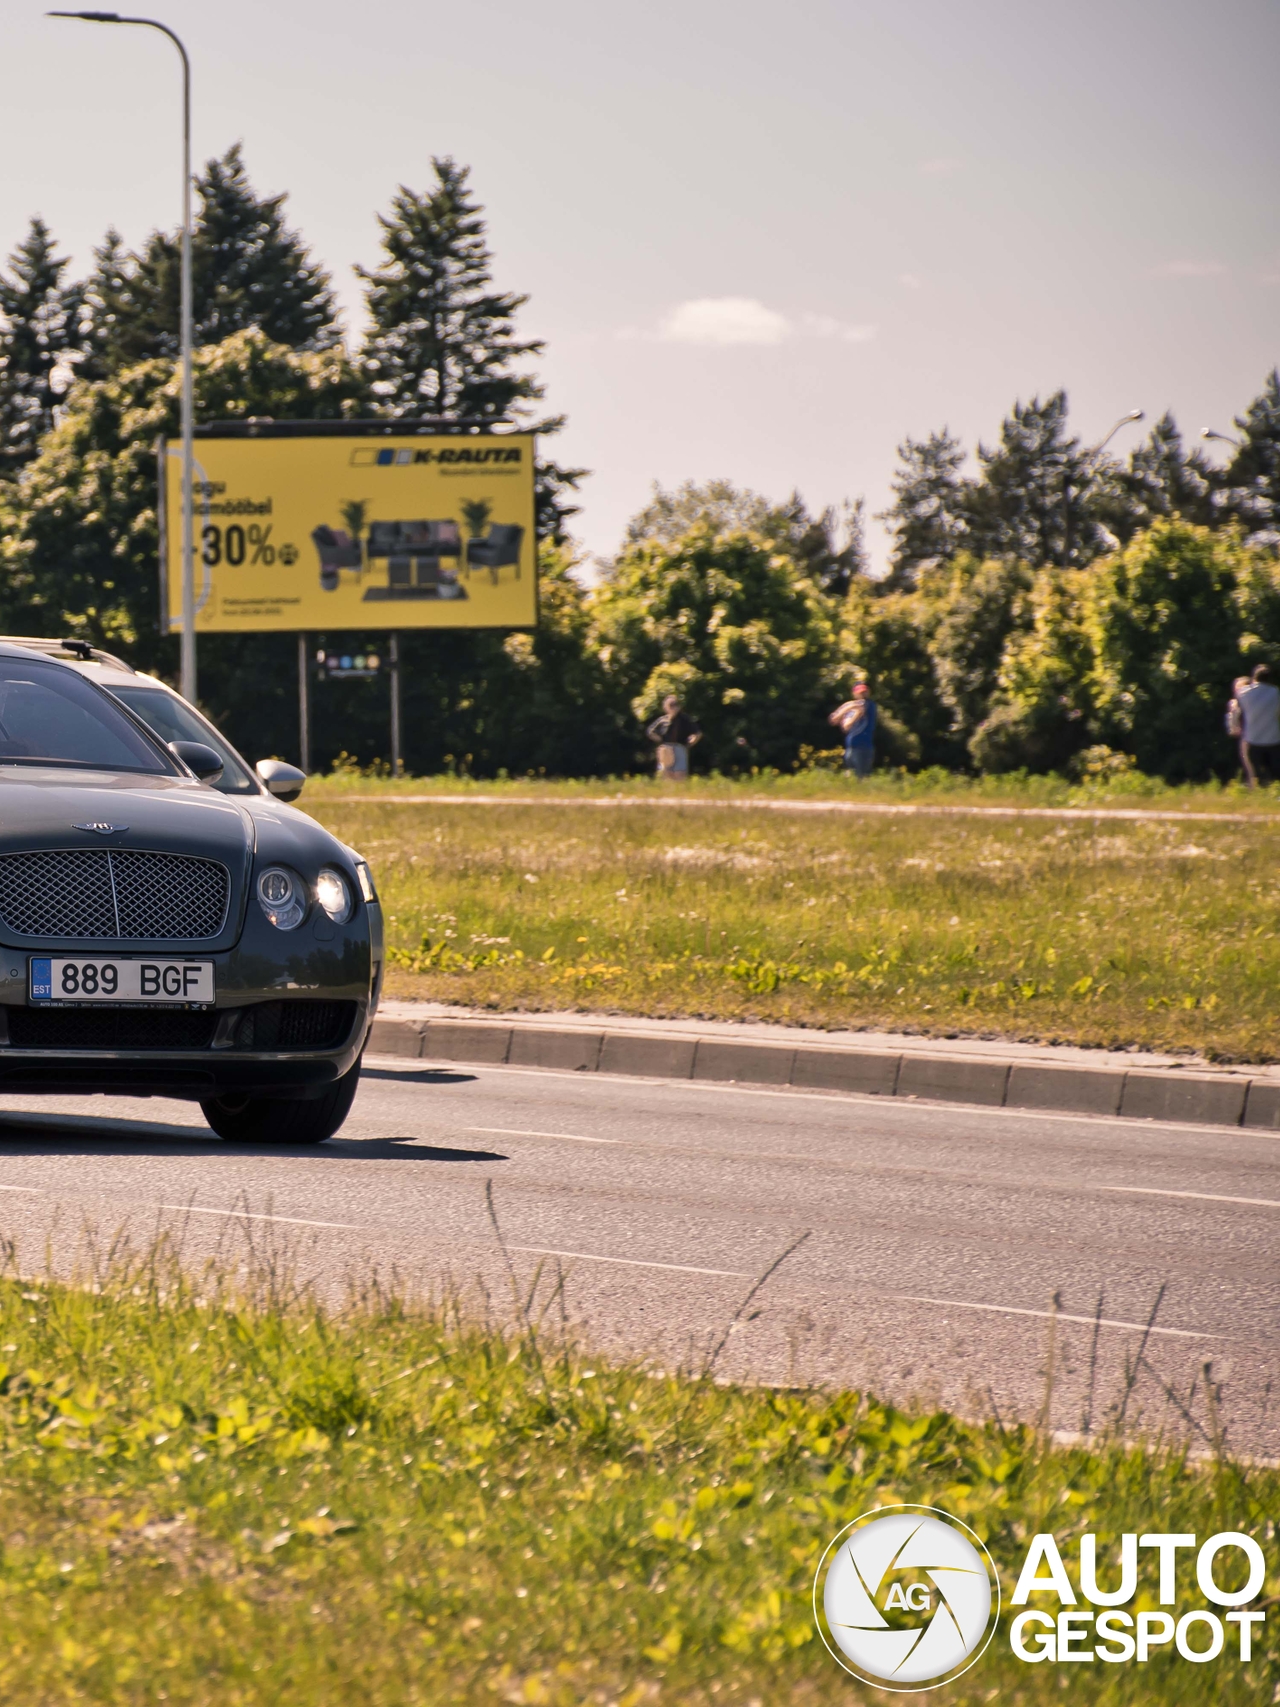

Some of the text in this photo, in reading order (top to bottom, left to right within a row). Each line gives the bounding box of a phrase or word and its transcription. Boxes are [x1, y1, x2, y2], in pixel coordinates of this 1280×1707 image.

[414, 448, 522, 463] K-RAUTA
[182, 481, 226, 499] ogu
[61, 963, 202, 997] 889 BGF
[33, 985, 51, 994] EST
